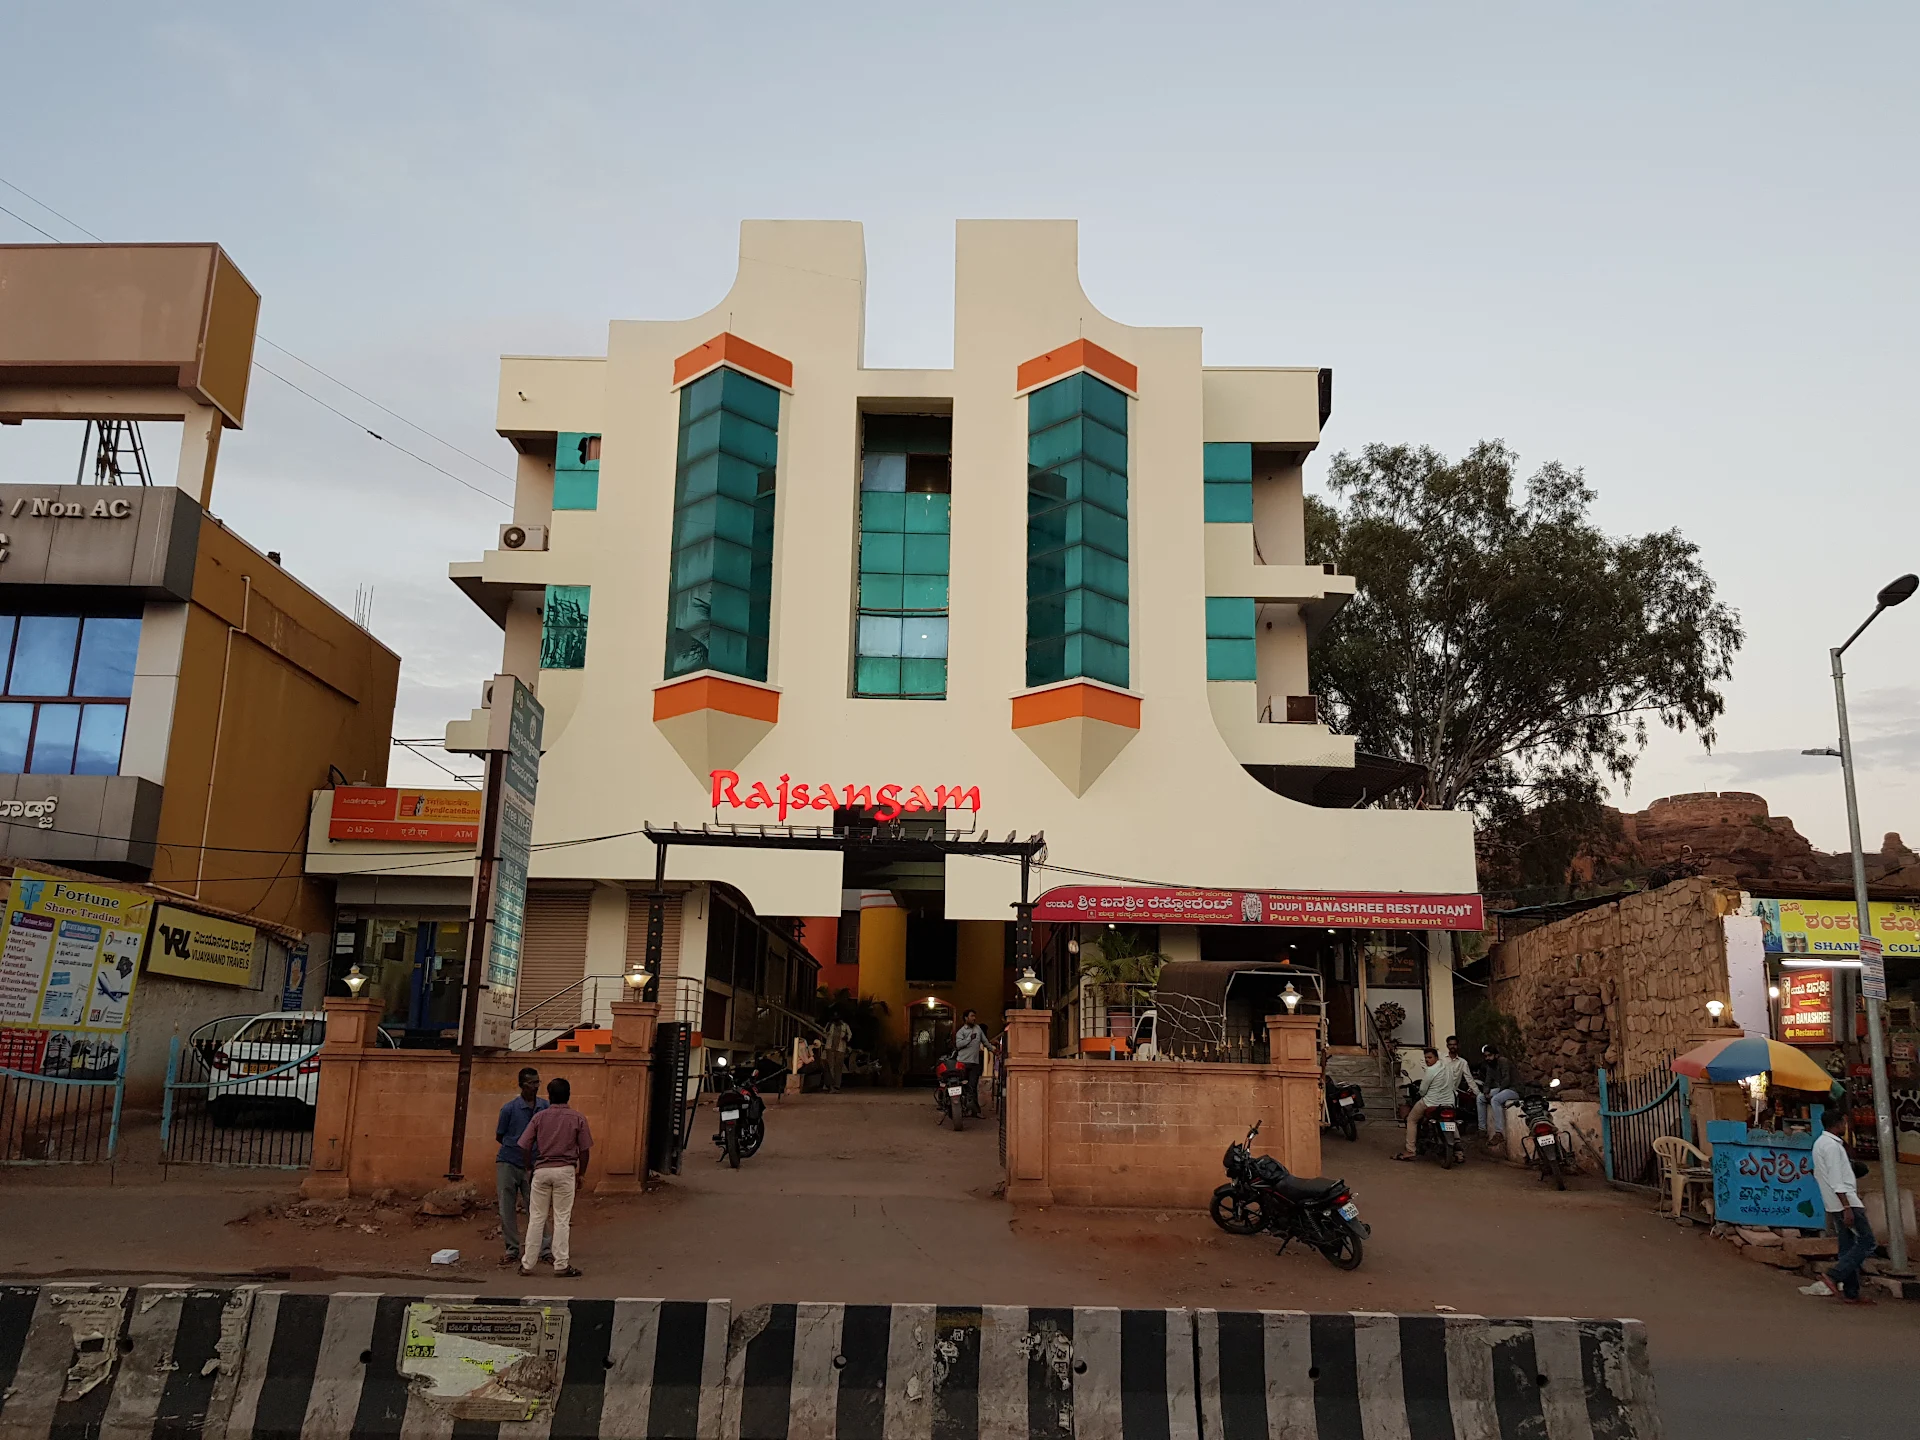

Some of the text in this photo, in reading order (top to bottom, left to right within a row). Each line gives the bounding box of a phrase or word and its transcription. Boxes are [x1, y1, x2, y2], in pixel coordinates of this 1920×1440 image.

[30, 498, 84, 518] Non
[90, 499, 130, 519] AC
[709, 769, 981, 822] Rajsangam
[425, 807, 480, 815] SyndicateBank
[54, 883, 119, 909] Fortune
[1076, 895, 1097, 911] ಶ್ರೀ
[44, 902, 120, 925] Share Trading
[1269, 902, 1472, 917] UDUPI BANASHREE RESTAURANT
[1269, 914, 1299, 922] Pure
[1327, 915, 1369, 925] Family
[1372, 916, 1442, 926] Restaurant
[192, 949, 250, 970] VIJAYANAND TRAVELS
[1796, 1011, 1831, 1025] BANASHREE
[1795, 1028, 1825, 1037] Restaurant
